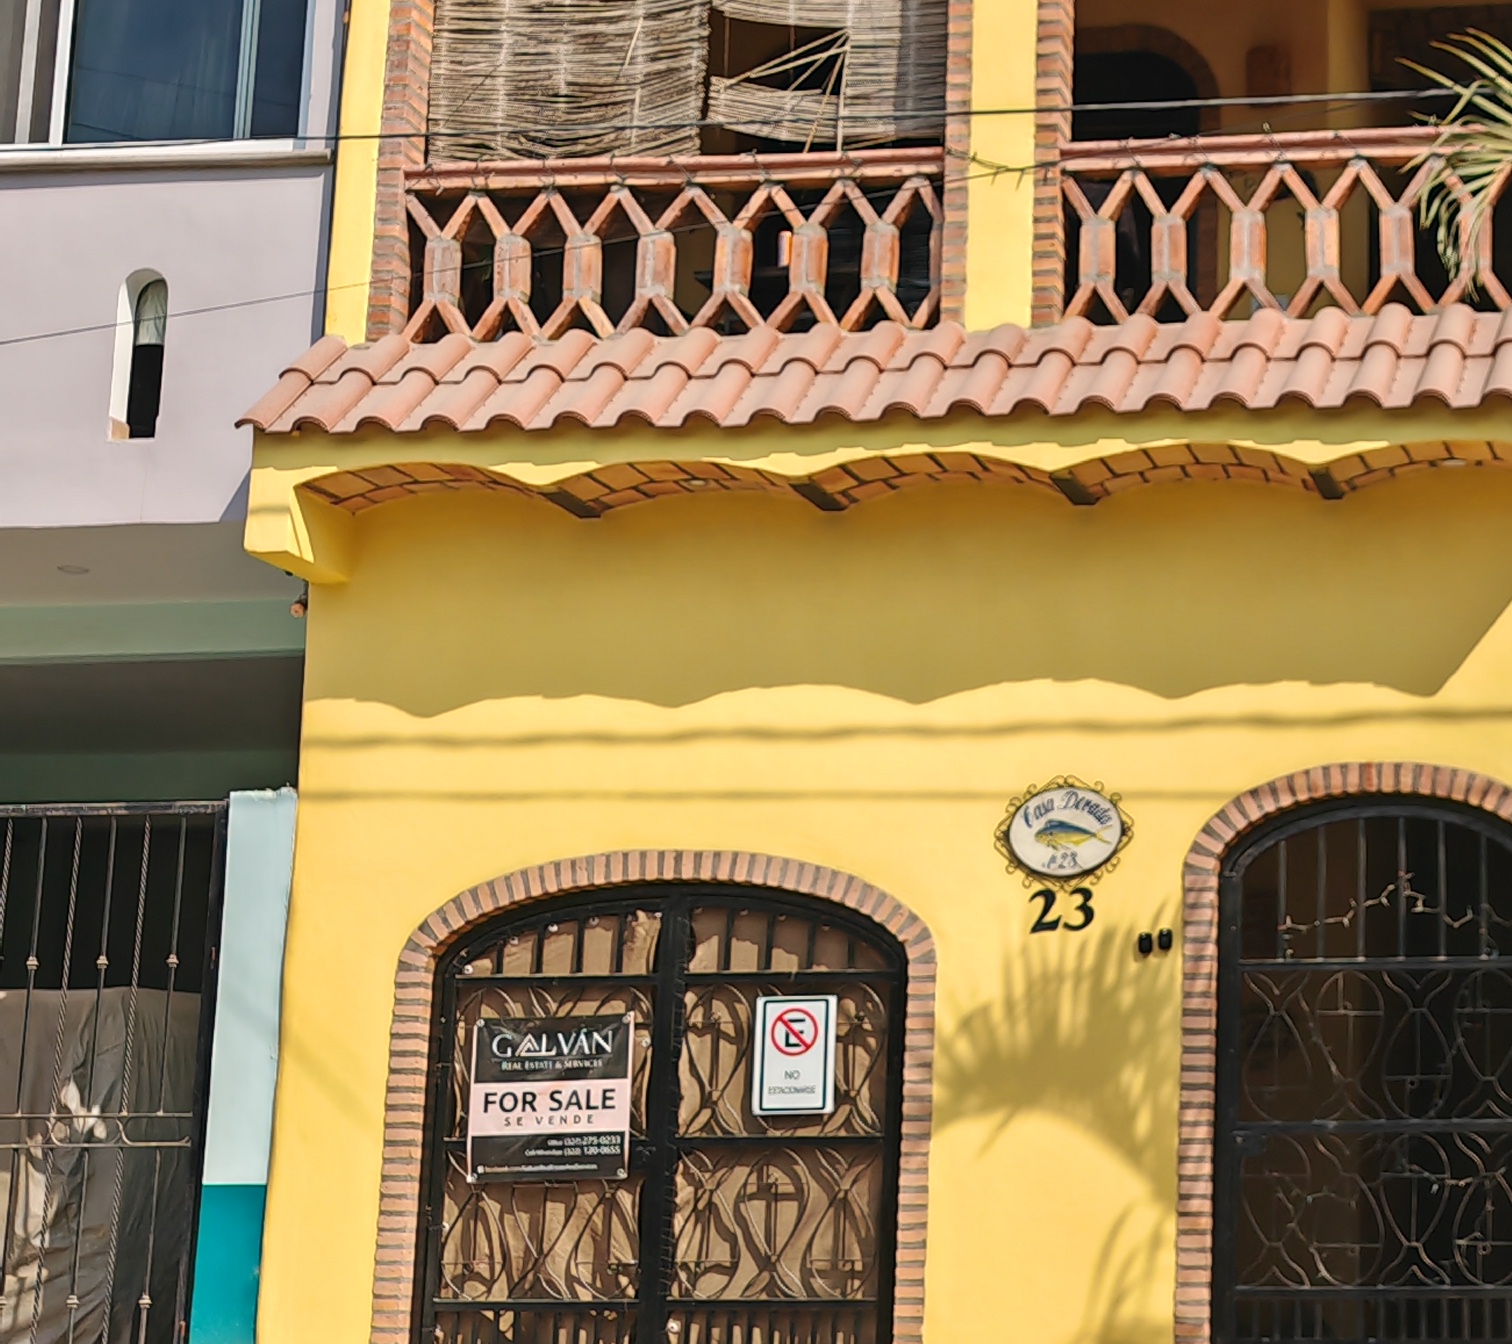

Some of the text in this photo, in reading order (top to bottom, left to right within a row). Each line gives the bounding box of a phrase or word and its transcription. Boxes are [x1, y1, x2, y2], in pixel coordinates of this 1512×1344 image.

[1020, 797, 1055, 829] Casa
[1028, 887, 1095, 934] 23
[491, 1028, 613, 1058] GALVÁN
[501, 1061, 523, 1071] REAL
[525, 1060, 552, 1070] ESTATE
[784, 1070, 801, 1080] NO
[483, 1088, 616, 1114] FOR SALE
[503, 1114, 594, 1127] SE VENDE
